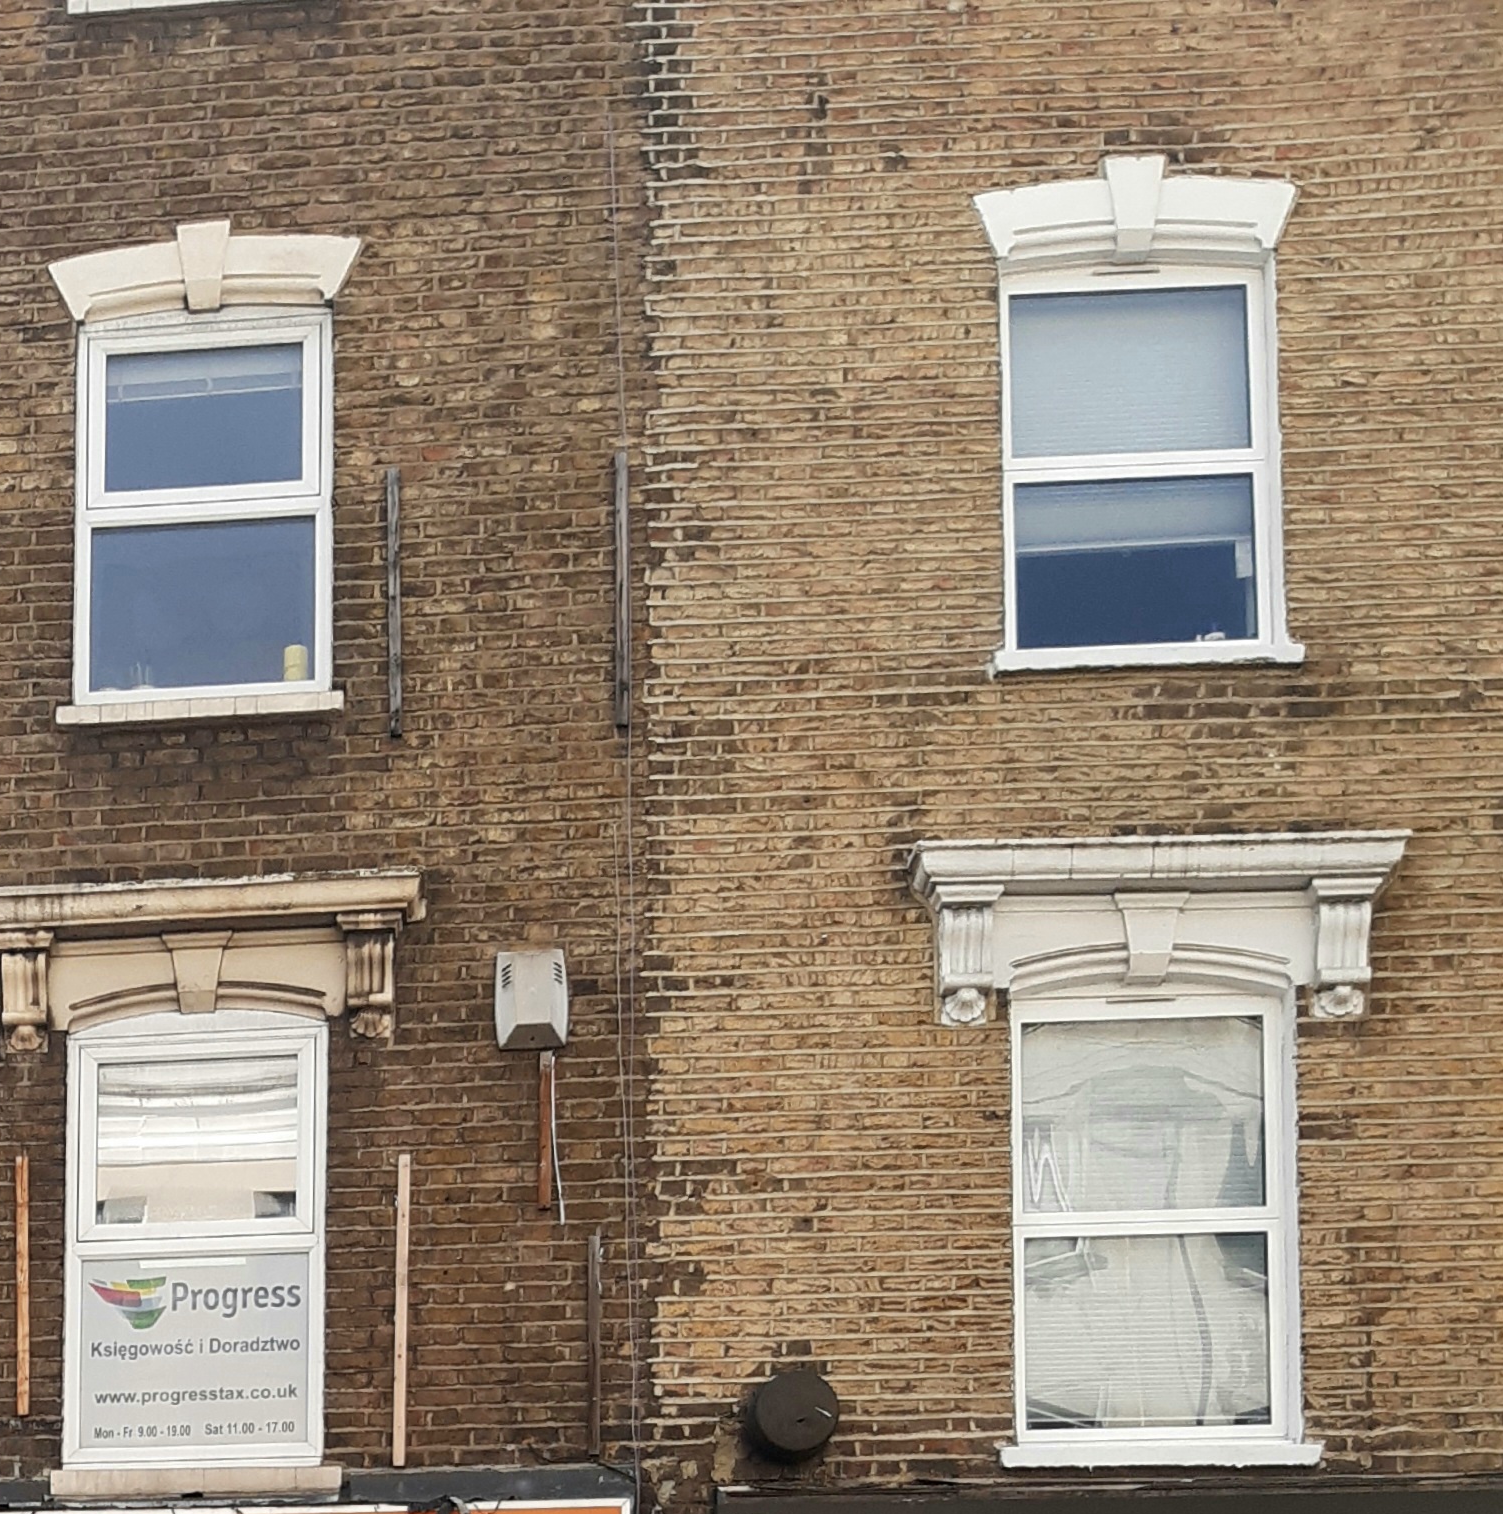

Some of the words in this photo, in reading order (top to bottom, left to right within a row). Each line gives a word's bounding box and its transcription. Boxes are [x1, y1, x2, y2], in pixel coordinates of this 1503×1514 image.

[171, 1282, 301, 1318] Progress
[91, 1339, 194, 1360] Księgowość
[209, 1337, 301, 1354] Doradztwo
[94, 1384, 299, 1406] www.progresstax.co.uk
[94, 1427, 114, 1439] Mon
[138, 1426, 157, 1437] 9.00
[166, 1425, 191, 1437] 19.00
[204, 1423, 224, 1435] Sat
[227, 1422, 255, 1434] 11.00
[265, 1421, 295, 1433] 17.00
